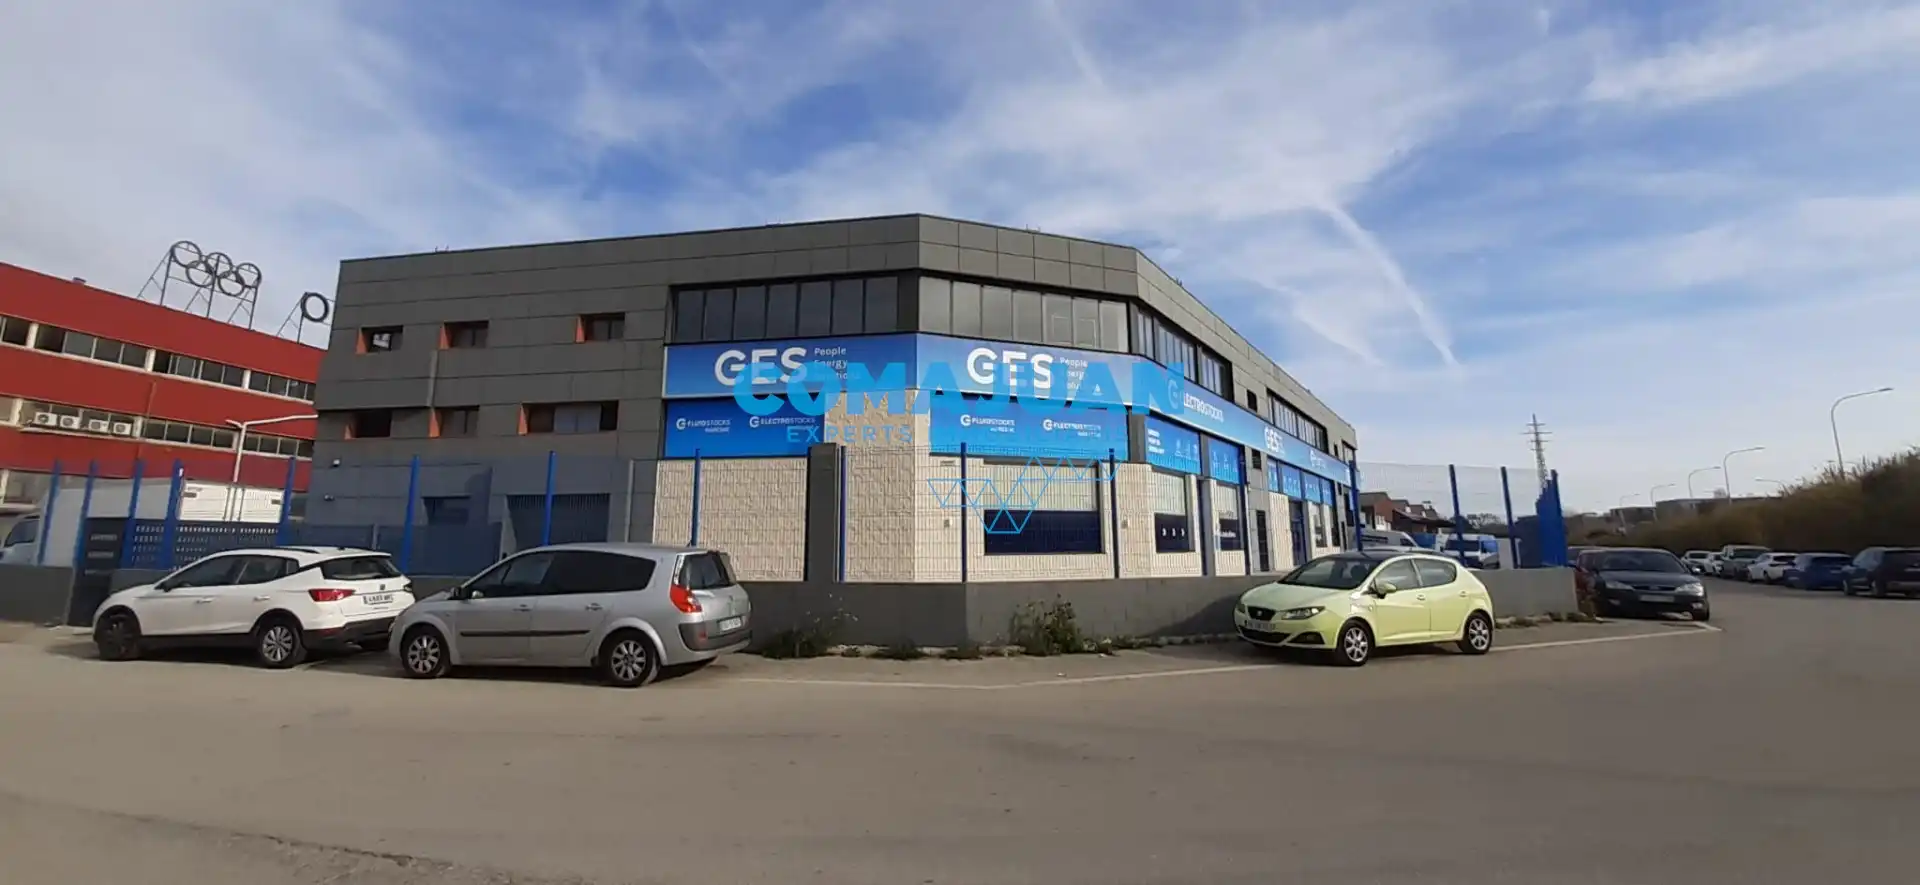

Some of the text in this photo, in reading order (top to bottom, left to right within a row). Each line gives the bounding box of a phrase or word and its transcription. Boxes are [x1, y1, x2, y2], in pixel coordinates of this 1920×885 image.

[714, 347, 807, 386] GES
[814, 346, 847, 357] People
[966, 347, 1055, 390] GES
